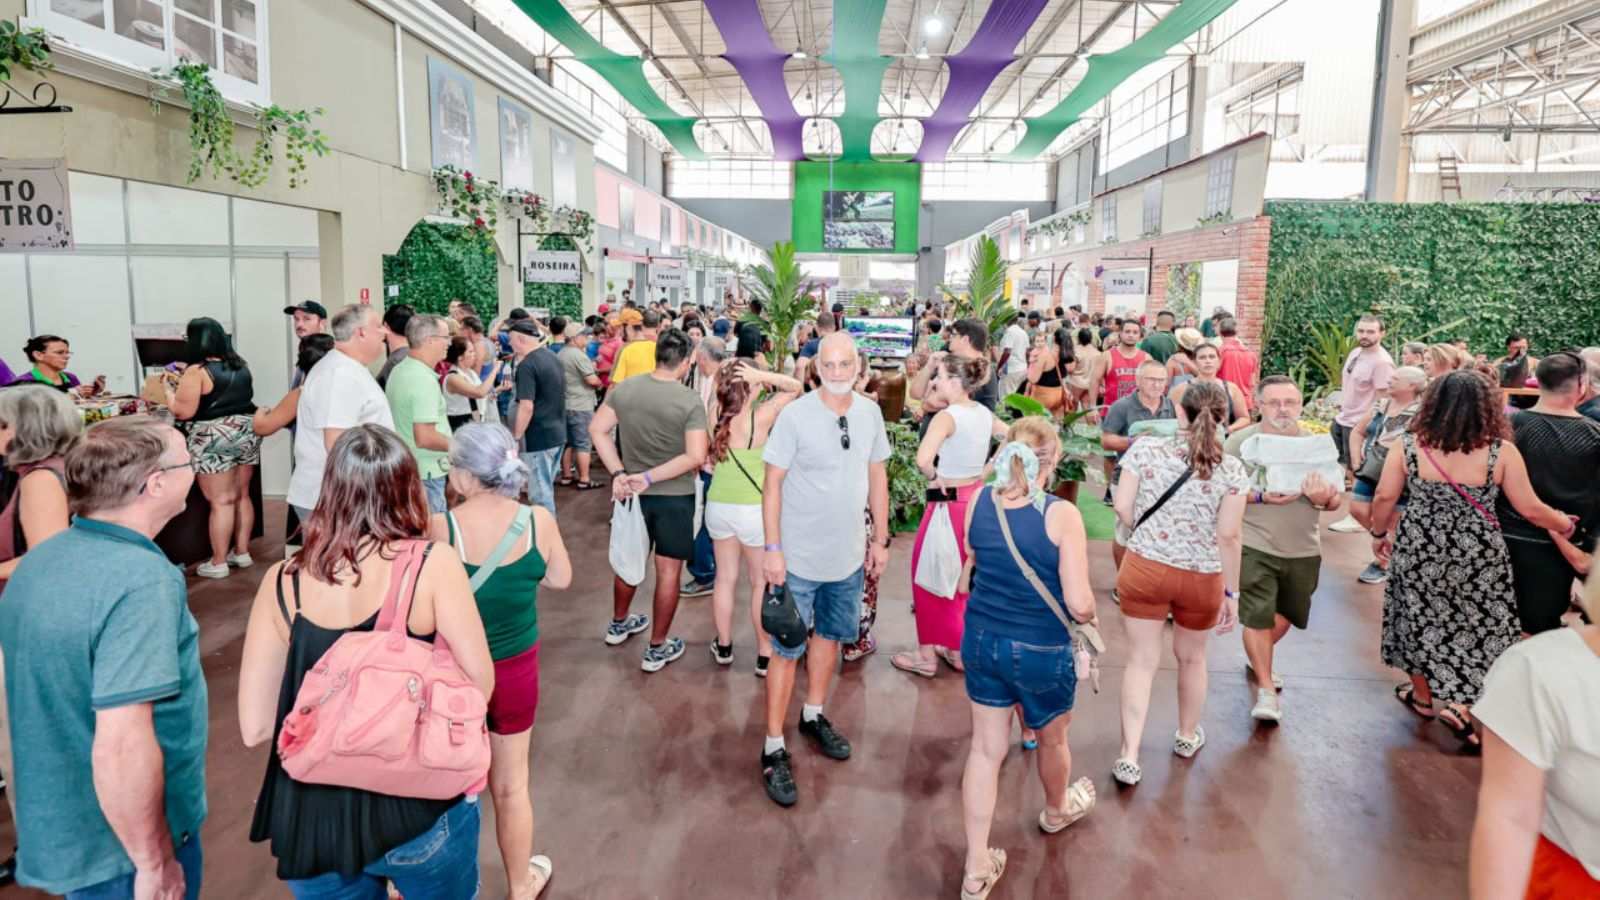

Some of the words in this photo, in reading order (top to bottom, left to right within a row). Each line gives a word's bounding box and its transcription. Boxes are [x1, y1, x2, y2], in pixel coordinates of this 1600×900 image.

[0, 180, 35, 201] TO
[0, 204, 53, 226] TRO
[530, 261, 576, 270] ROSEIRA
